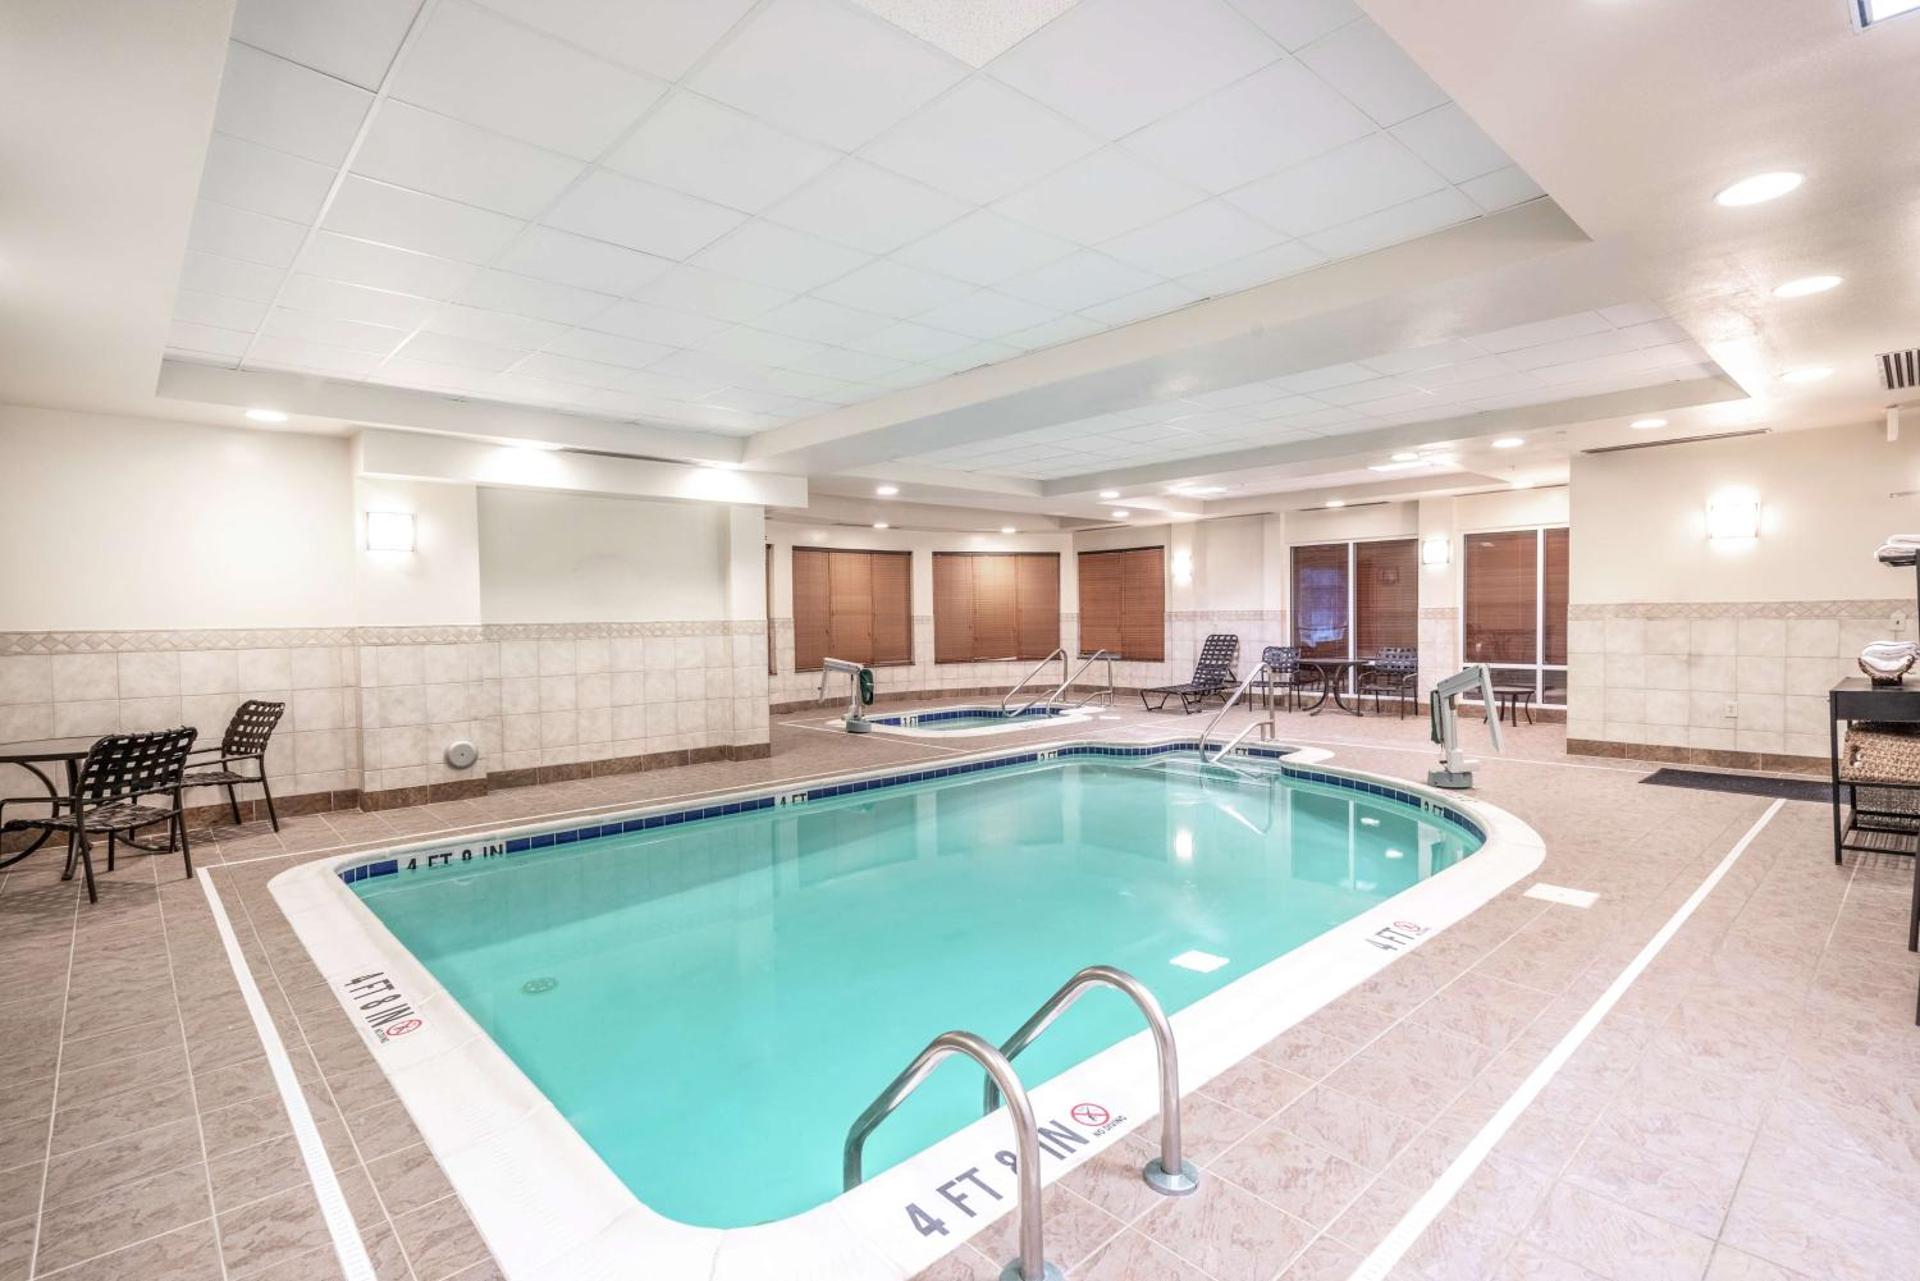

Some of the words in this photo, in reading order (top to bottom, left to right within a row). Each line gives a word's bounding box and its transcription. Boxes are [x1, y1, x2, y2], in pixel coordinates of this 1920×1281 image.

[428, 852, 453, 868] FT
[483, 844, 504, 858] IN
[1364, 938, 1398, 951] 4
[1375, 926, 1415, 946] FT
[344, 971, 385, 987] 4
[349, 978, 395, 1001] FT
[360, 993, 402, 1011] 8
[365, 1002, 415, 1029] IN
[905, 1202, 950, 1238] 4
[935, 1166, 1004, 1219] FT
[1037, 1119, 1090, 1161] IN
